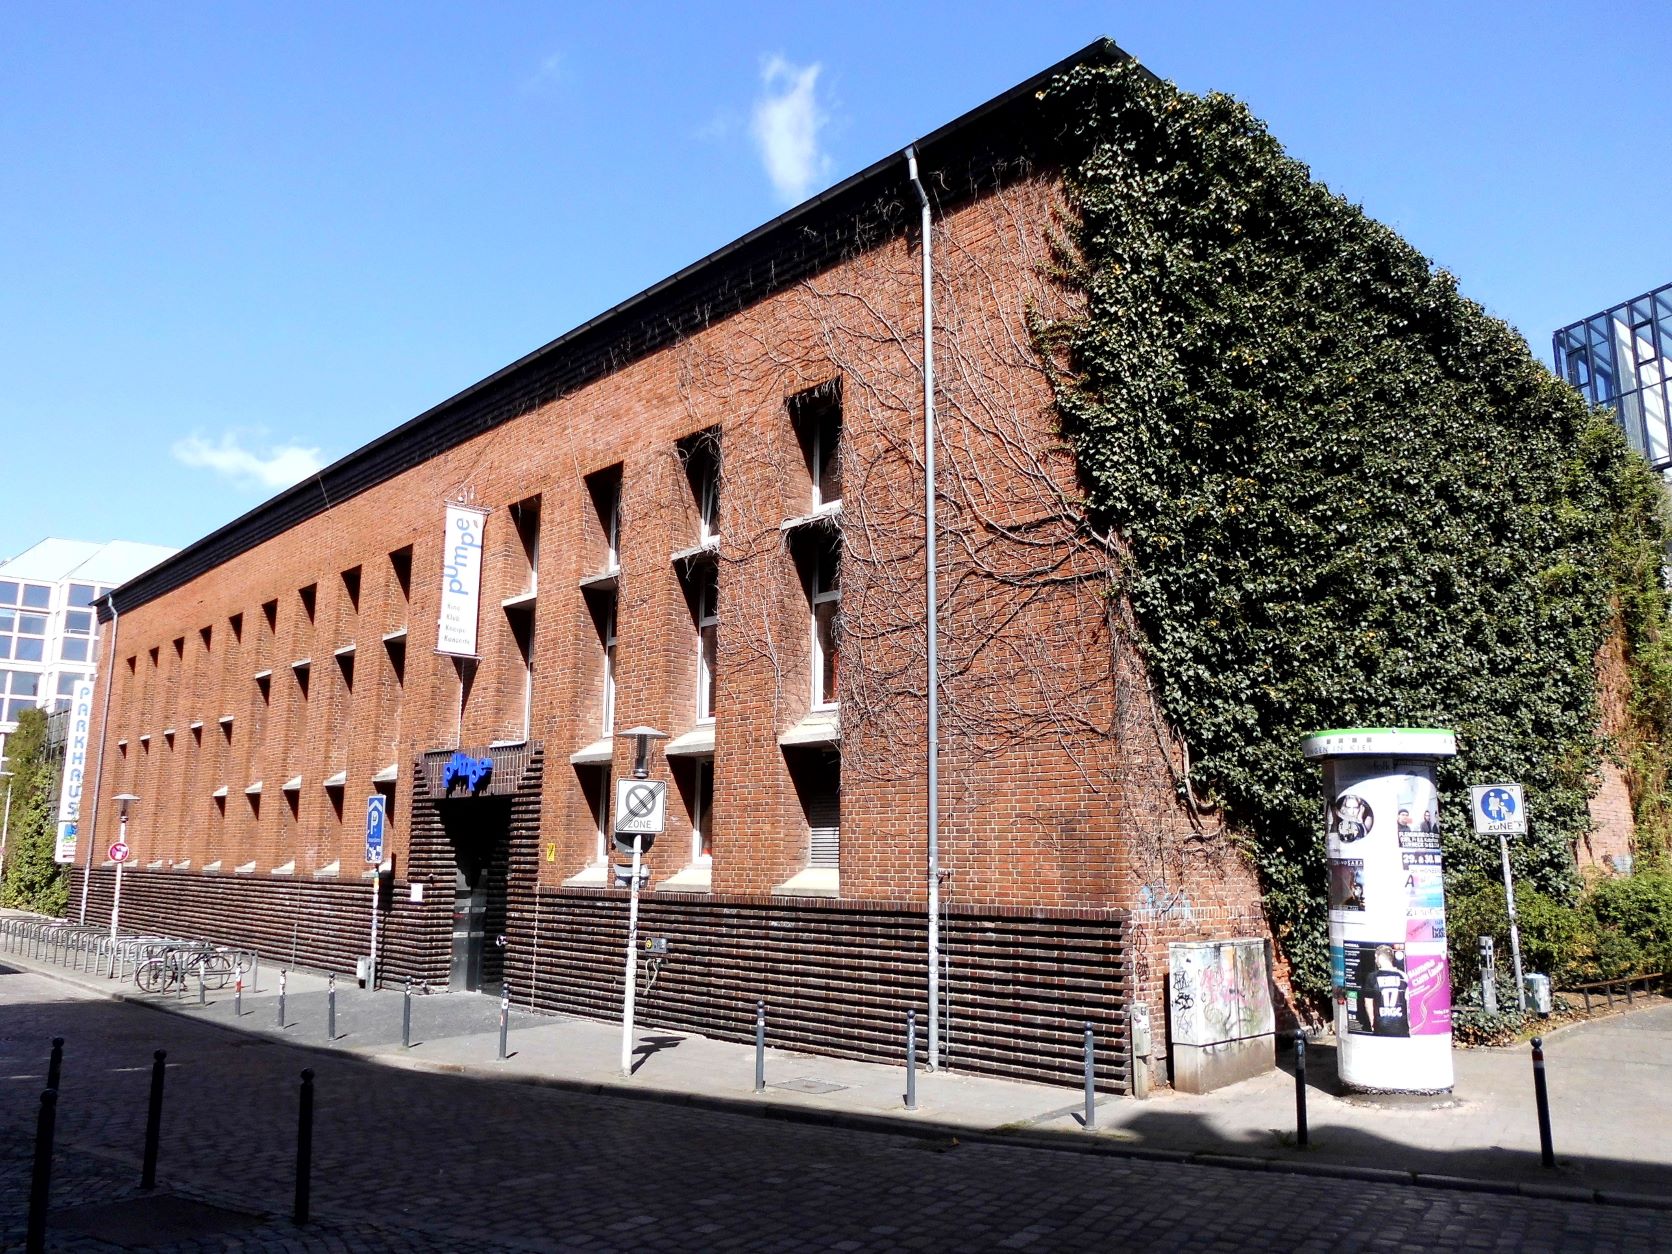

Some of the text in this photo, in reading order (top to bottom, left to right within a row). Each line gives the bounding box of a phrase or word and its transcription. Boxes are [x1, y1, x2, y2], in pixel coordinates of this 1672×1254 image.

[444, 517, 482, 596] pumpe
[67, 686, 91, 815] PARKHAUS
[443, 752, 493, 792] pumpe
[628, 820, 652, 829] ZONE
